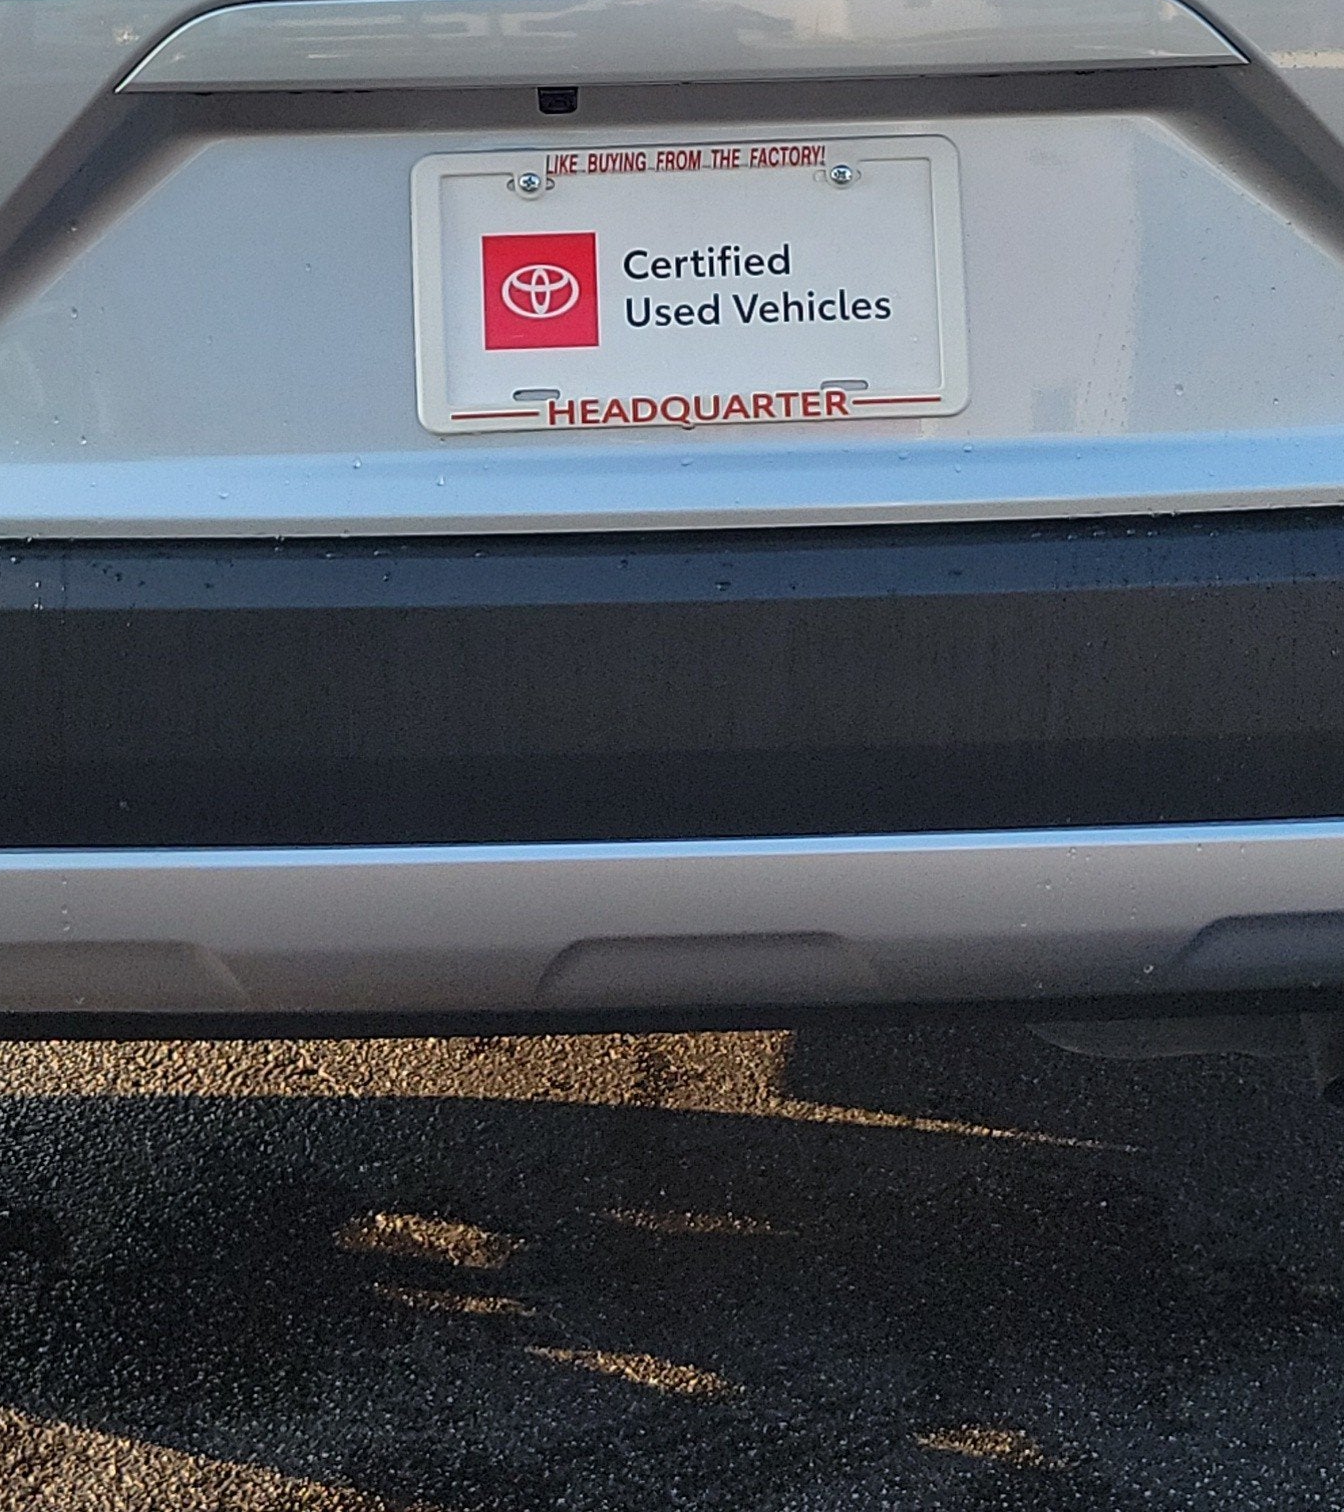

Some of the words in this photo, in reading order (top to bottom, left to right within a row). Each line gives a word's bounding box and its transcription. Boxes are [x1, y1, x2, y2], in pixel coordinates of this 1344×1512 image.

[545, 153, 579, 176] LIKE
[587, 151, 647, 173] BUYING
[656, 150, 703, 171] FROM
[710, 148, 742, 169] THE
[749, 145, 827, 168] FACTORY!
[623, 243, 792, 280] Certified
[625, 292, 721, 328] Used
[732, 289, 892, 324] Vehicles
[548, 390, 850, 426] HEADQUARTER
